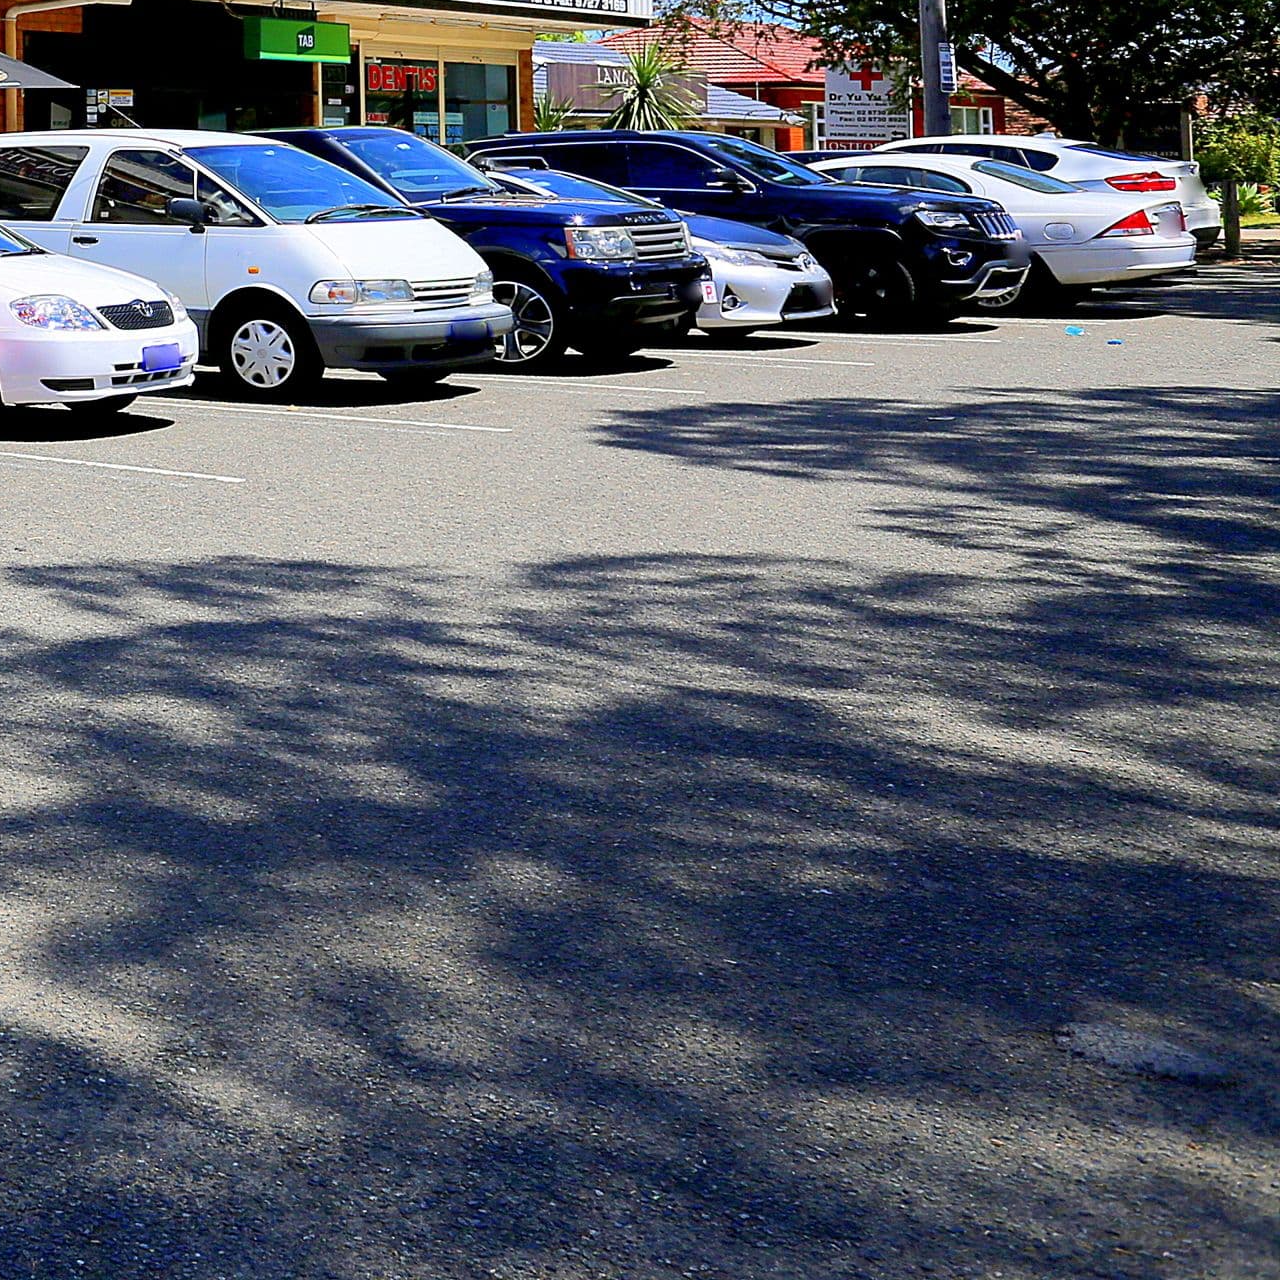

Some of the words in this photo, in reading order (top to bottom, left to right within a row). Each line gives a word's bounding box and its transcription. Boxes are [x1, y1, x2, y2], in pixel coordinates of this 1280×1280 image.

[298, 33, 314, 48] TAB
[829, 93, 842, 101] Dr
[846, 93, 861, 101] Yu
[866, 93, 880, 101] Yu
